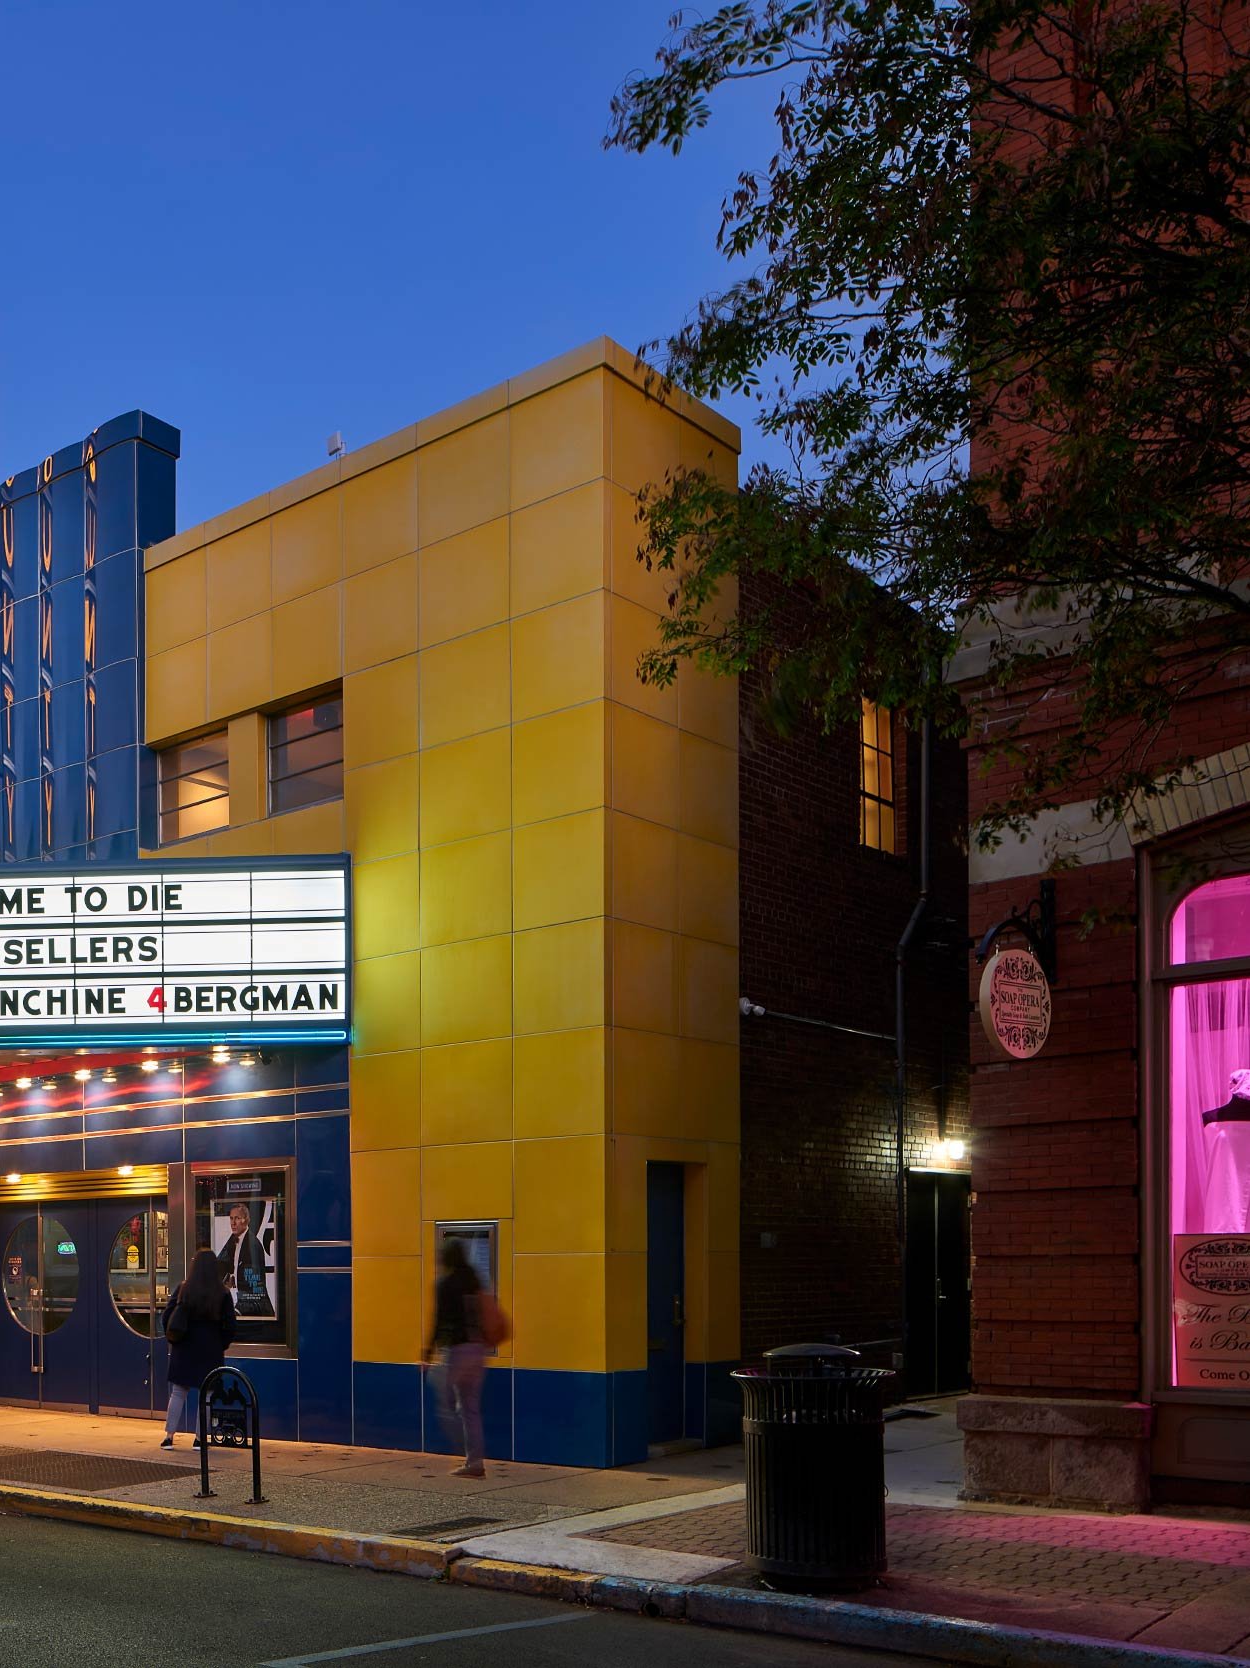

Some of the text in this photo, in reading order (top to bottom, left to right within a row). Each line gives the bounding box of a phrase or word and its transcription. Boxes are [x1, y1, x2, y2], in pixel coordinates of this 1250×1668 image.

[64, 885, 108, 913] TO
[128, 884, 183, 911] DIE
[4, 935, 158, 965] SELLERS
[146, 986, 167, 1013] 4
[173, 983, 339, 1013] BERGMAN
[1001, 991, 1039, 1007] SOAP OPERA
[1199, 1261, 1226, 1269] SOAP
[1182, 1303, 1222, 1324] The
[1189, 1336, 1203, 1349] is
[1200, 1369, 1235, 1380] Come
